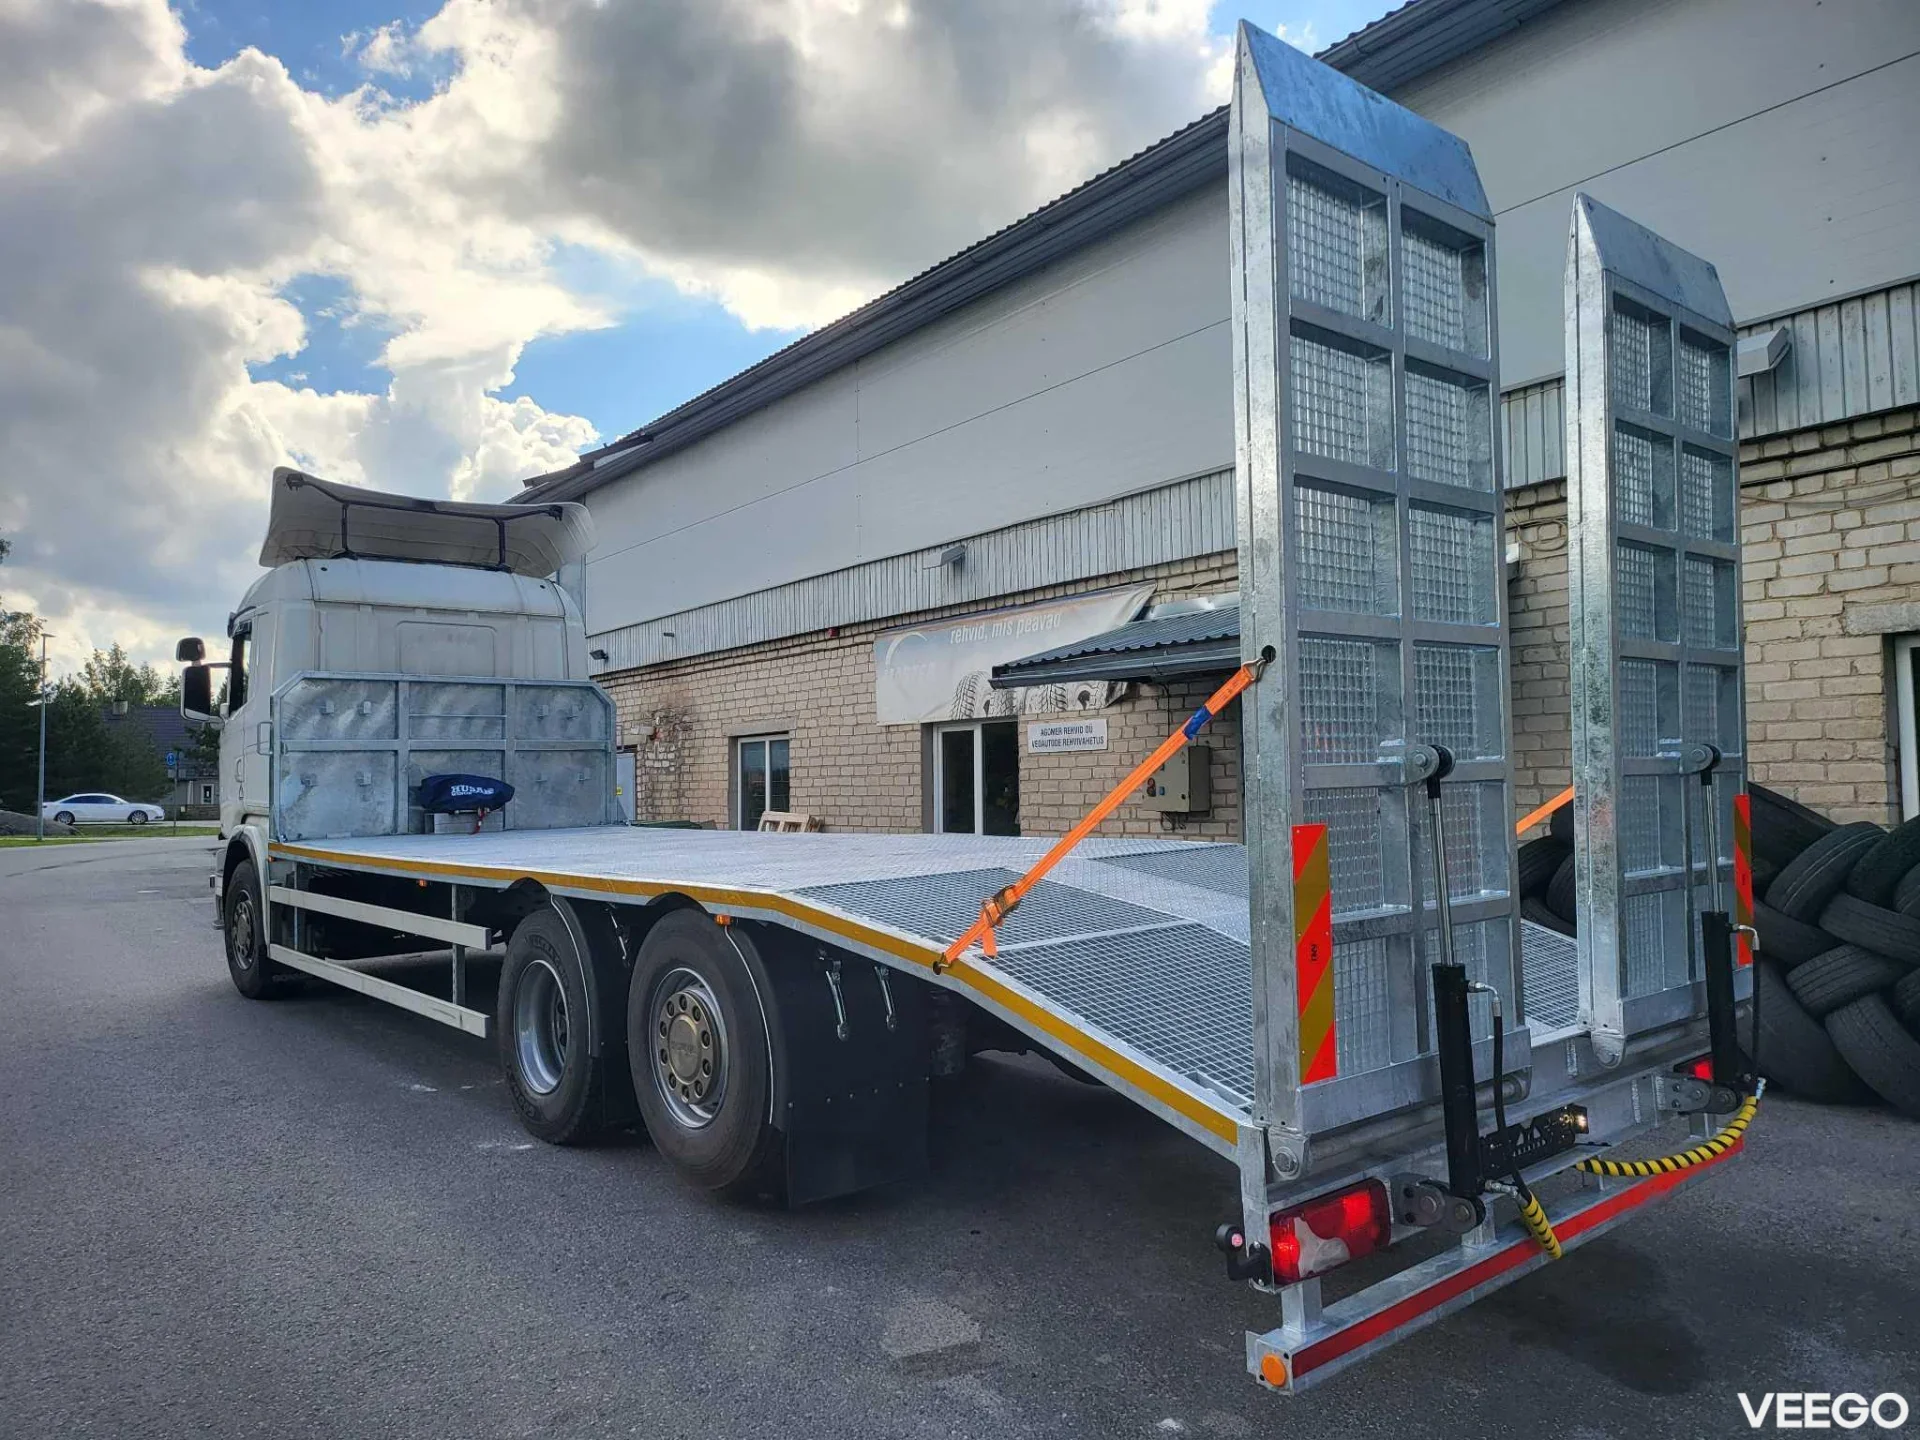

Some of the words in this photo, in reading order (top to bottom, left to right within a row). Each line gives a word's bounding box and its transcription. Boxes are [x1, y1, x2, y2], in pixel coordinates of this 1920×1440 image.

[950, 622, 988, 645] rehvid,
[991, 619, 1013, 638] mis
[1063, 725, 1084, 735] REHVID
[1062, 735, 1104, 747] REHVIVAHETUS
